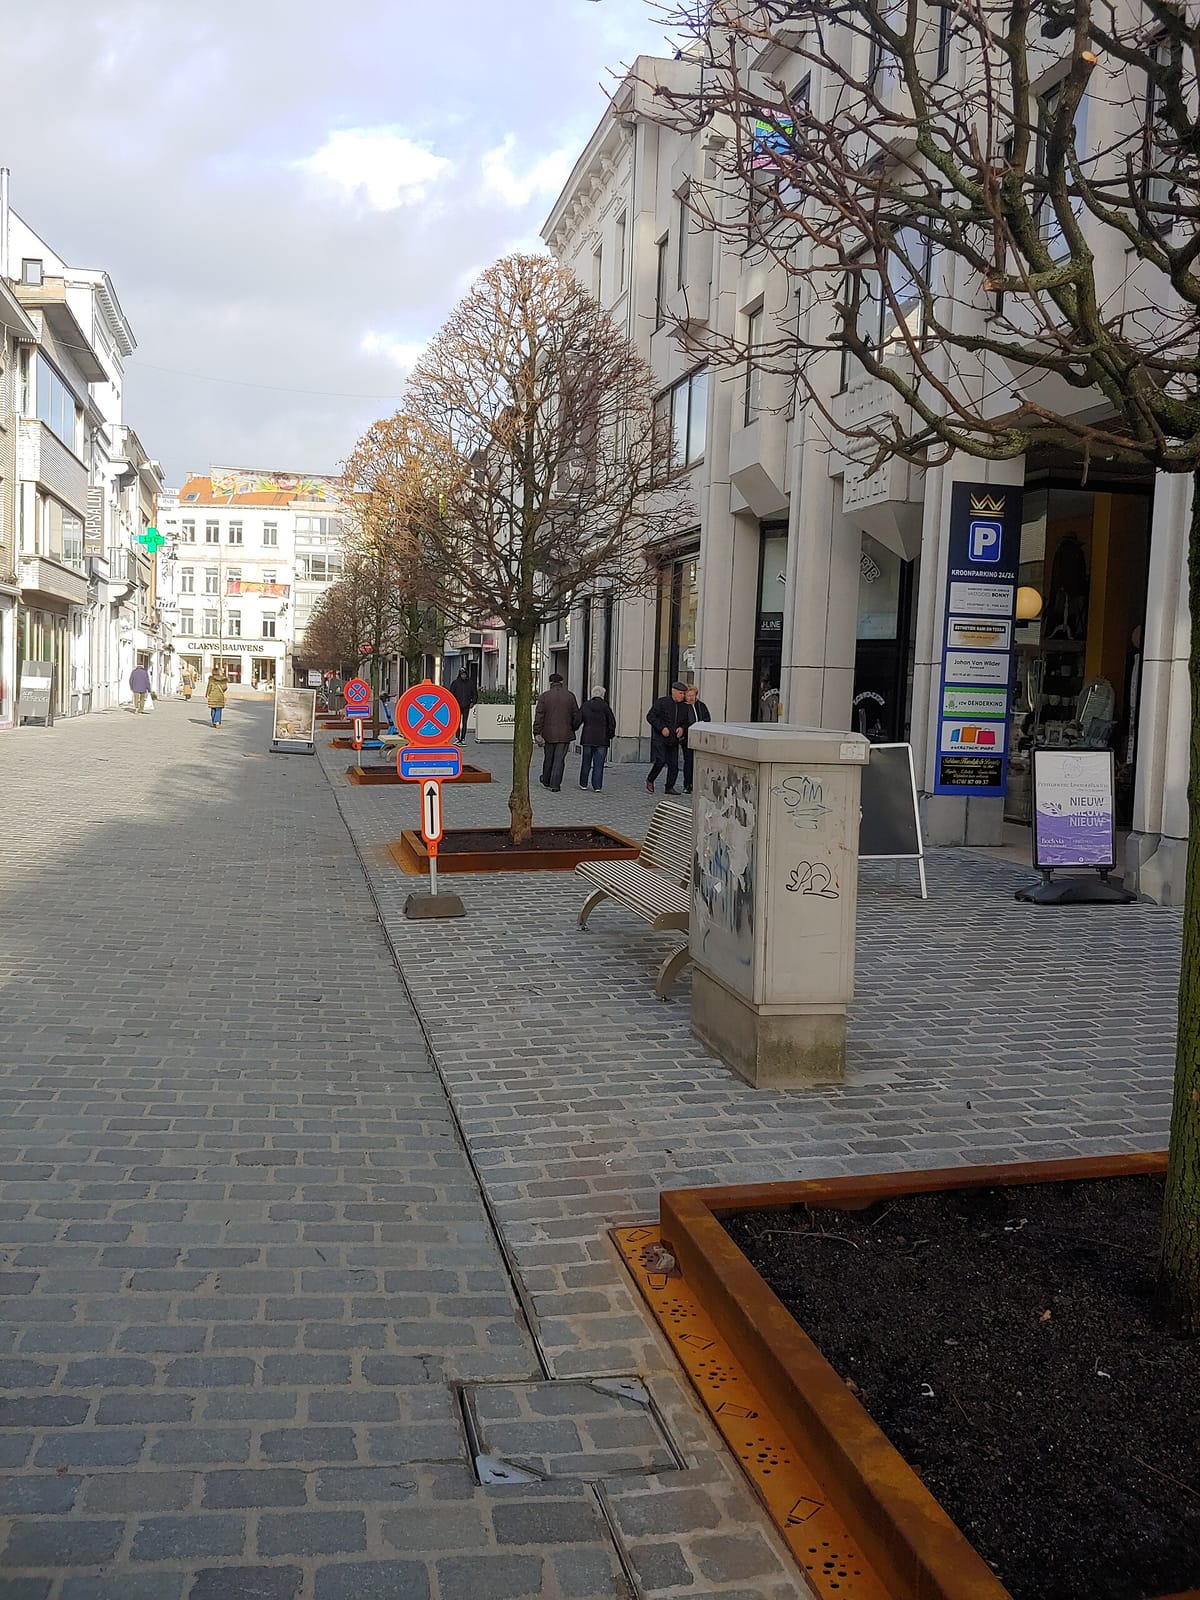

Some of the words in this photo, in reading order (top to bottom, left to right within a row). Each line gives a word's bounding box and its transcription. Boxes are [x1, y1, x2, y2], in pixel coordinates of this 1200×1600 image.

[973, 526, 997, 556] P
[951, 569, 998, 578] KROONPARKING
[187, 642, 220, 651] CLAEYS
[222, 643, 265, 652] BAUWENS
[1070, 817, 1104, 827] NIEUW
